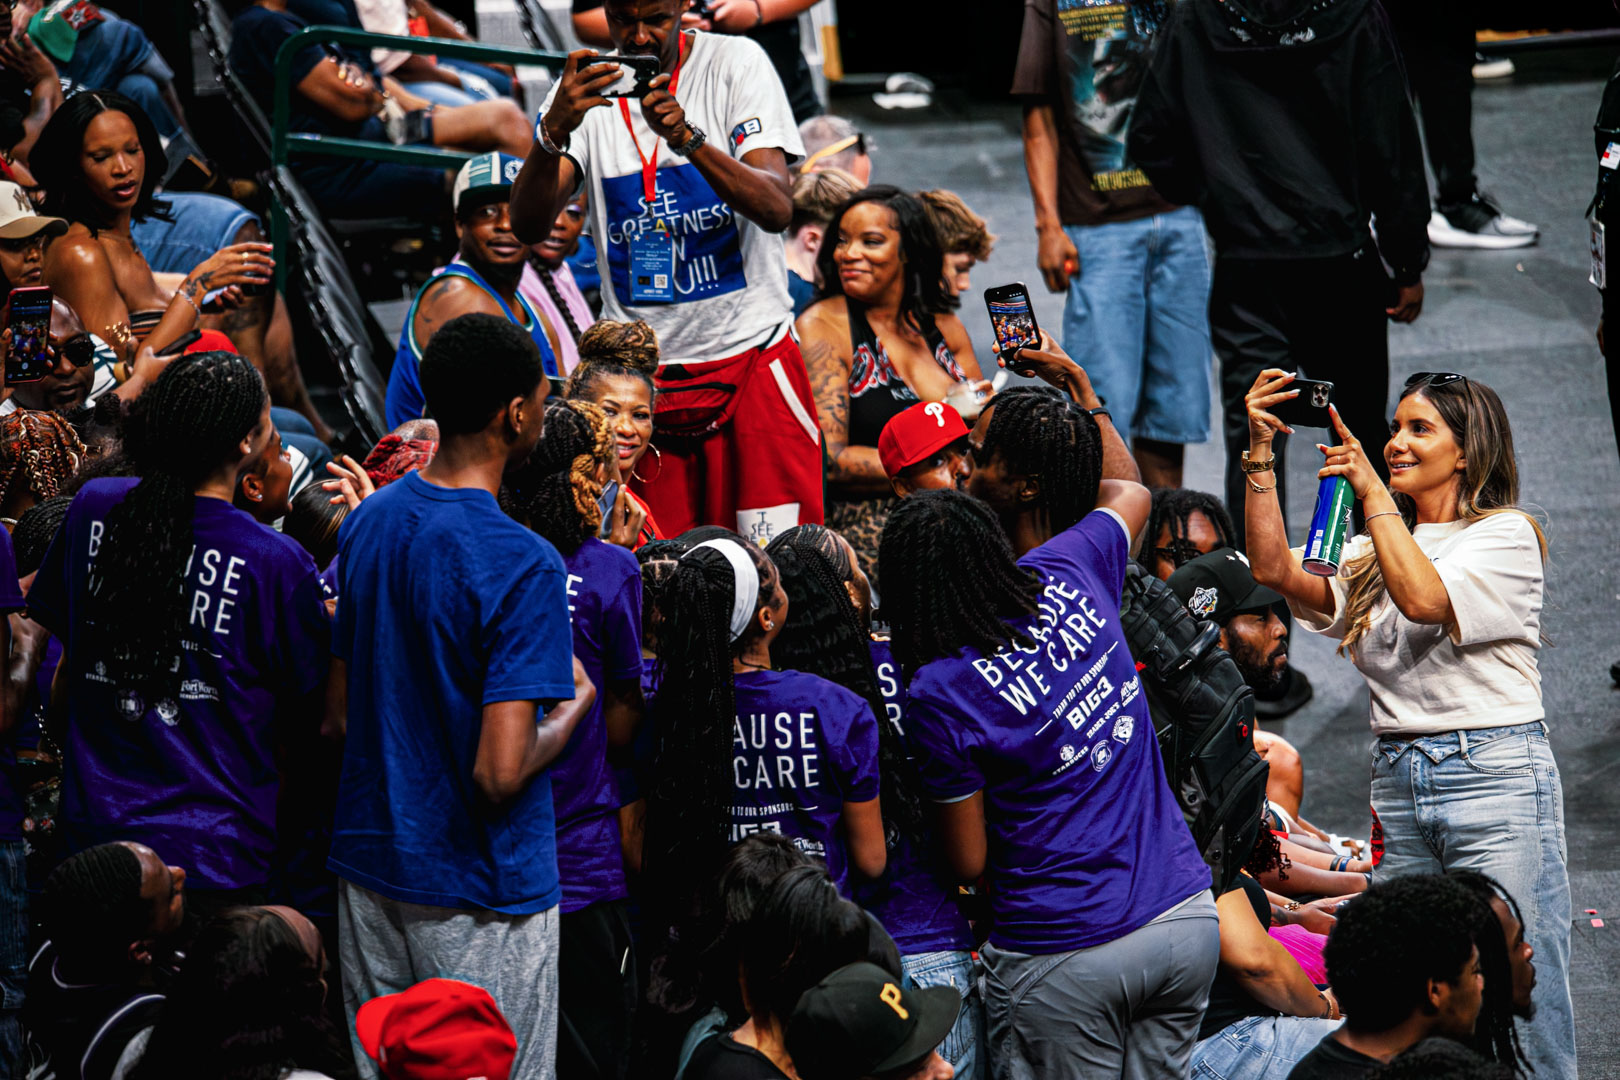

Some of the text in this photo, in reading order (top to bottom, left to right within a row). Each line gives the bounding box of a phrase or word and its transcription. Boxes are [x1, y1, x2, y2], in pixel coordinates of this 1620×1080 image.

[607, 202, 731, 244] GREATNESS
[637, 192, 679, 219] SEE
[924, 402, 945, 427] P
[751, 522, 775, 537] SEE
[999, 597, 1107, 715] WE CARE
[1066, 675, 1115, 730] BIG3
[732, 711, 817, 750] AUSE
[733, 753, 821, 789] CARE
[1052, 745, 1090, 775] STARBUCKS
[759, 802, 794, 816] SPONSORS
[880, 982, 909, 1019] P
